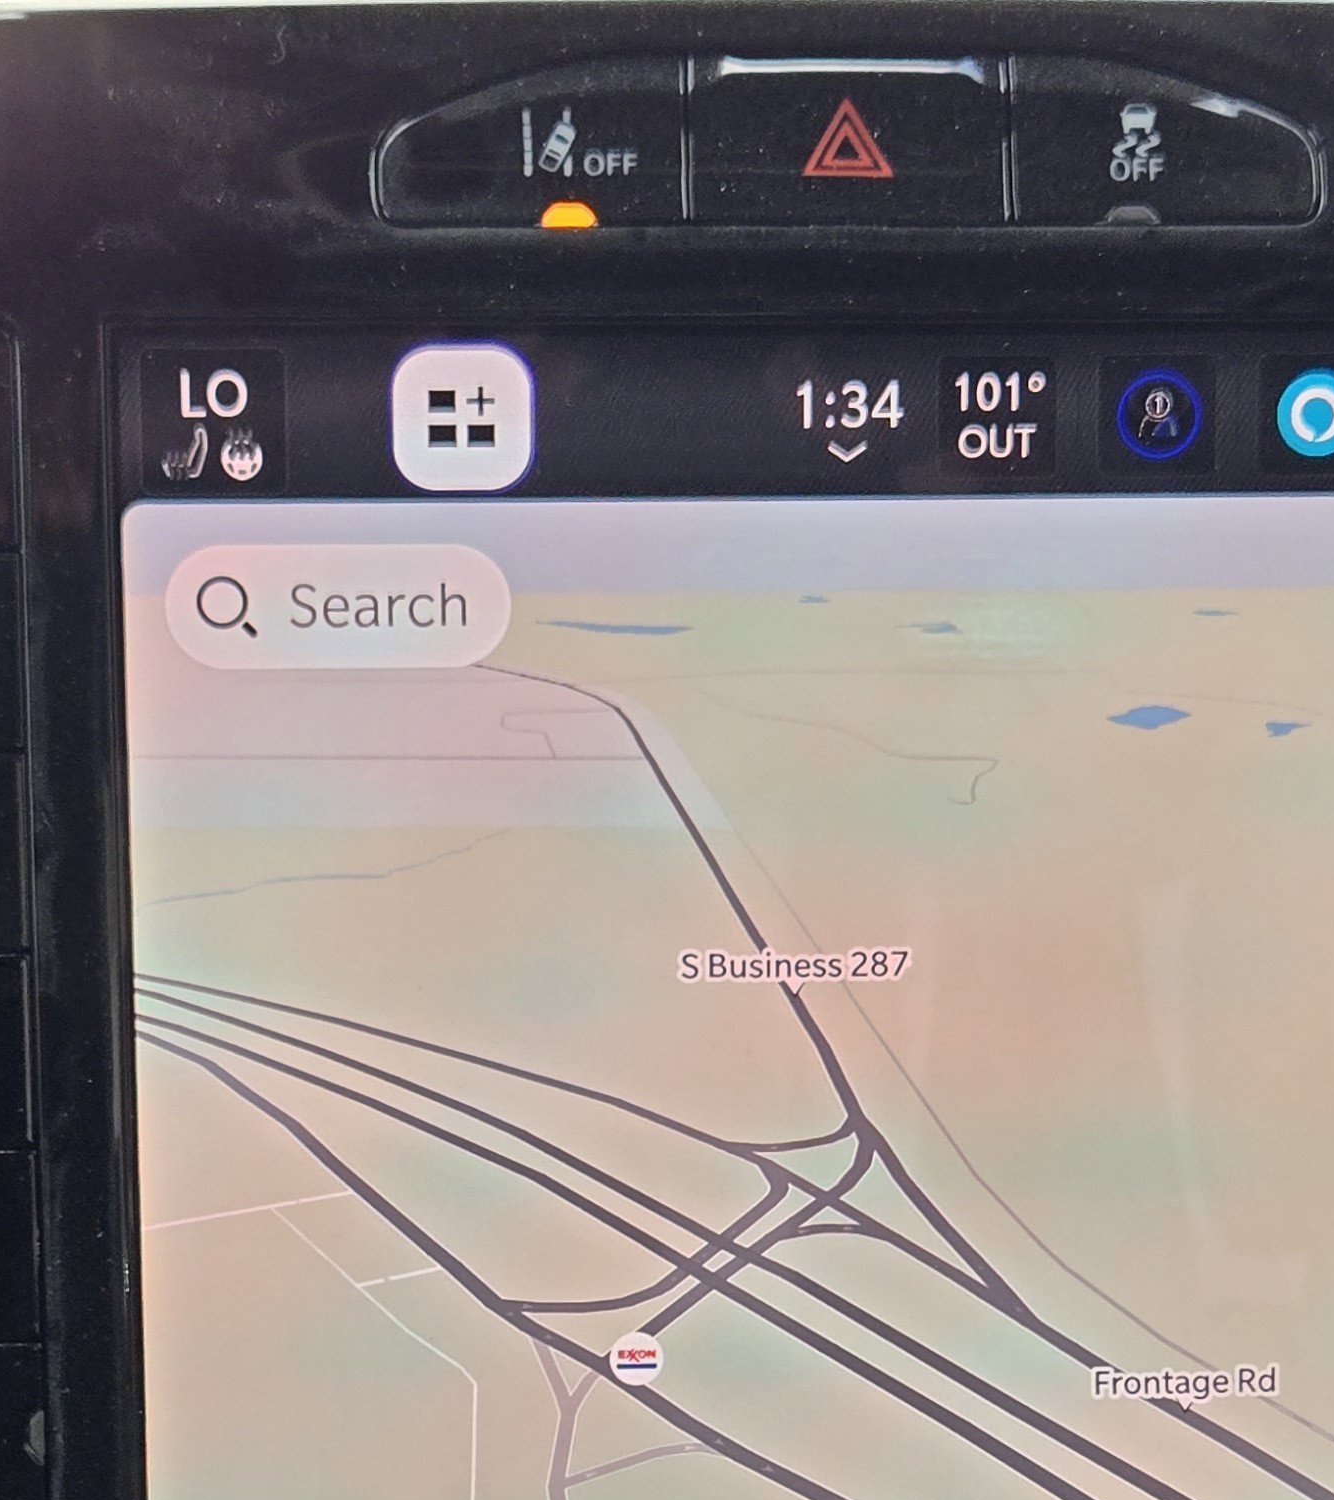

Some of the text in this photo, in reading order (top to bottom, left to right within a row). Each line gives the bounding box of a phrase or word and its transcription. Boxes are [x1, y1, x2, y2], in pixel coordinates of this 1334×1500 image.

[582, 151, 639, 178] OFF
[1109, 157, 1165, 183] OFF
[179, 367, 249, 419] LO
[796, 377, 905, 430] 1:34
[958, 423, 1037, 459] OUT
[289, 582, 469, 630] Search
[680, 950, 910, 980] S Business 287
[1094, 1366, 1277, 1400] Frontage Rd
